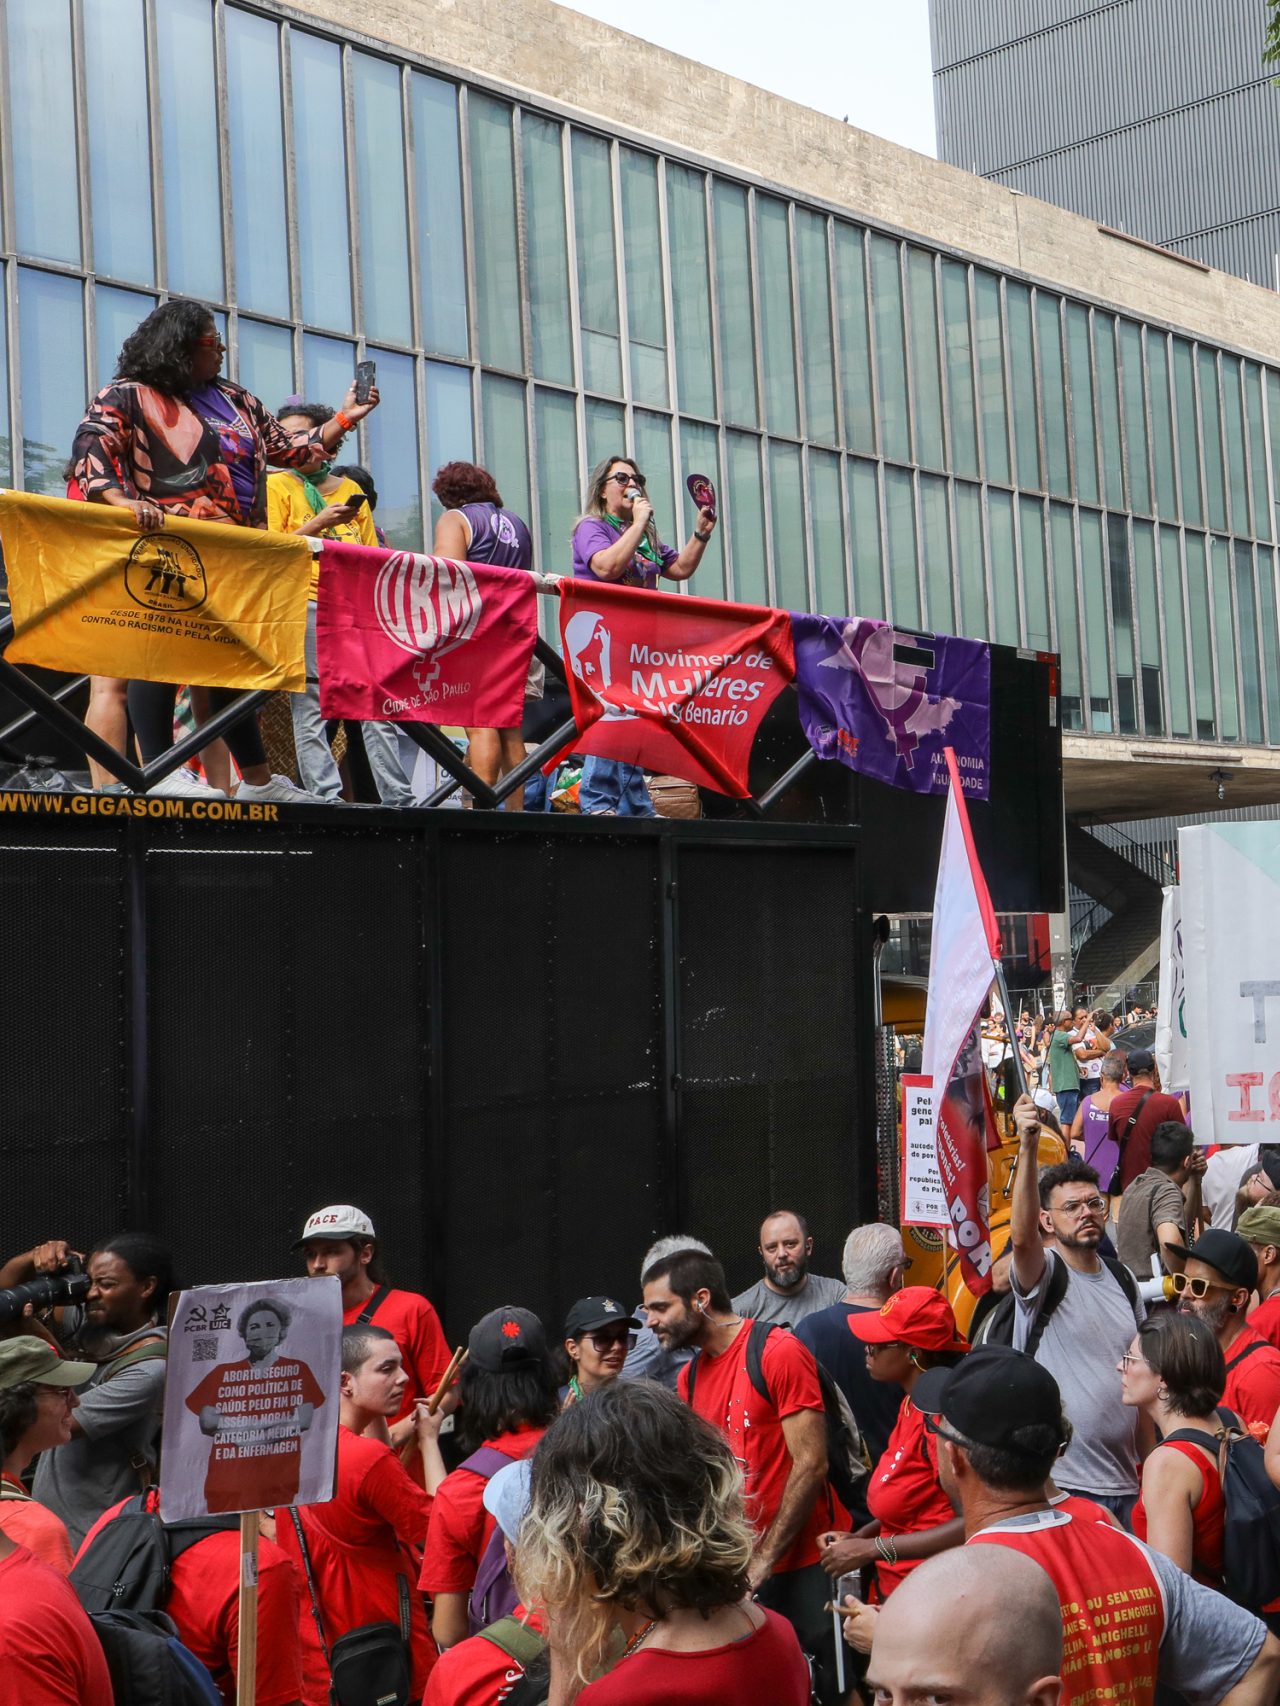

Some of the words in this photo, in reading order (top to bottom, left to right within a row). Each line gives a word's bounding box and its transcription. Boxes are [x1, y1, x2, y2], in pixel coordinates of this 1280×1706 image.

[380, 553, 477, 650] UBM
[81, 615, 117, 626] CONTRA
[118, 619, 126, 627] O
[128, 621, 174, 634] RACISMO
[176, 628, 182, 636] E
[184, 630, 211, 641] PELA
[213, 635, 241, 646] VIDA!
[110, 610, 140, 618] DESDE
[144, 613, 166, 623] 1978
[168, 616, 182, 626] NA
[185, 621, 211, 632] LUTA
[744, 650, 774, 670] de
[442, 681, 471, 697] PAULO
[686, 700, 748, 726] Benario
[0, 792, 279, 822] WWW.GIGASOM.COM.BR
[308, 1214, 338, 1228] PACE
[950, 1195, 993, 1278] POR
[184, 1324, 206, 1332] PCBR
[223, 1368, 261, 1382] ABORTO
[262, 1364, 300, 1378] SEGURO
[218, 1386, 246, 1398] COMO
[248, 1380, 289, 1396] POLÍTICA
[291, 1378, 303, 1390] DE
[216, 1400, 247, 1414] SAÚDE
[248, 1397, 272, 1412] PELO
[273, 1396, 289, 1408] FIM
[291, 1394, 304, 1406] DO
[218, 1414, 258, 1429] ASSÉDIO
[260, 1410, 292, 1426] MORAL
[214, 1429, 265, 1444] CATEGORIA
[266, 1424, 301, 1440] MÉDICA
[216, 1448, 222, 1460] E
[223, 1447, 236, 1460] DA
[238, 1440, 298, 1458] ENFERMAGEM
[1087, 1597, 1102, 1610] OU
[1107, 1591, 1130, 1606] SEM
[1094, 1613, 1110, 1627] OU
